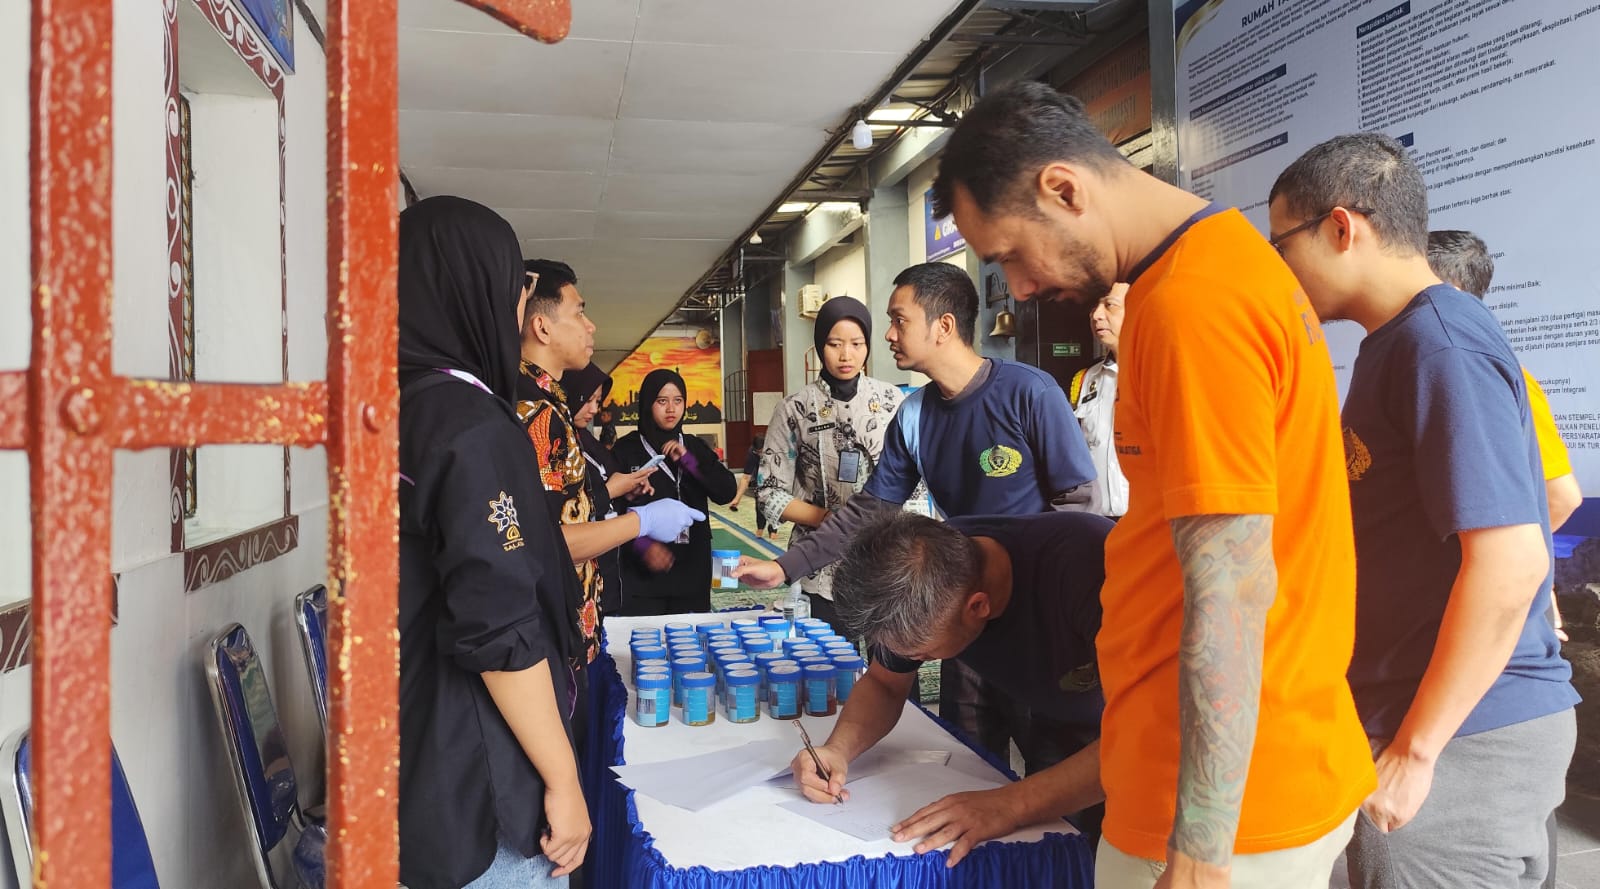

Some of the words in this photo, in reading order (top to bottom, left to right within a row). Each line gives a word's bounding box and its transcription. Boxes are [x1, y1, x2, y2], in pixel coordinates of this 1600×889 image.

[1242, 0, 1275, 28] RUMAH
[1545, 146, 1565, 157] kondisi
[1566, 137, 1596, 152] kesehatan
[1528, 325, 1537, 333] hak
[1584, 329, 1599, 339] yang
